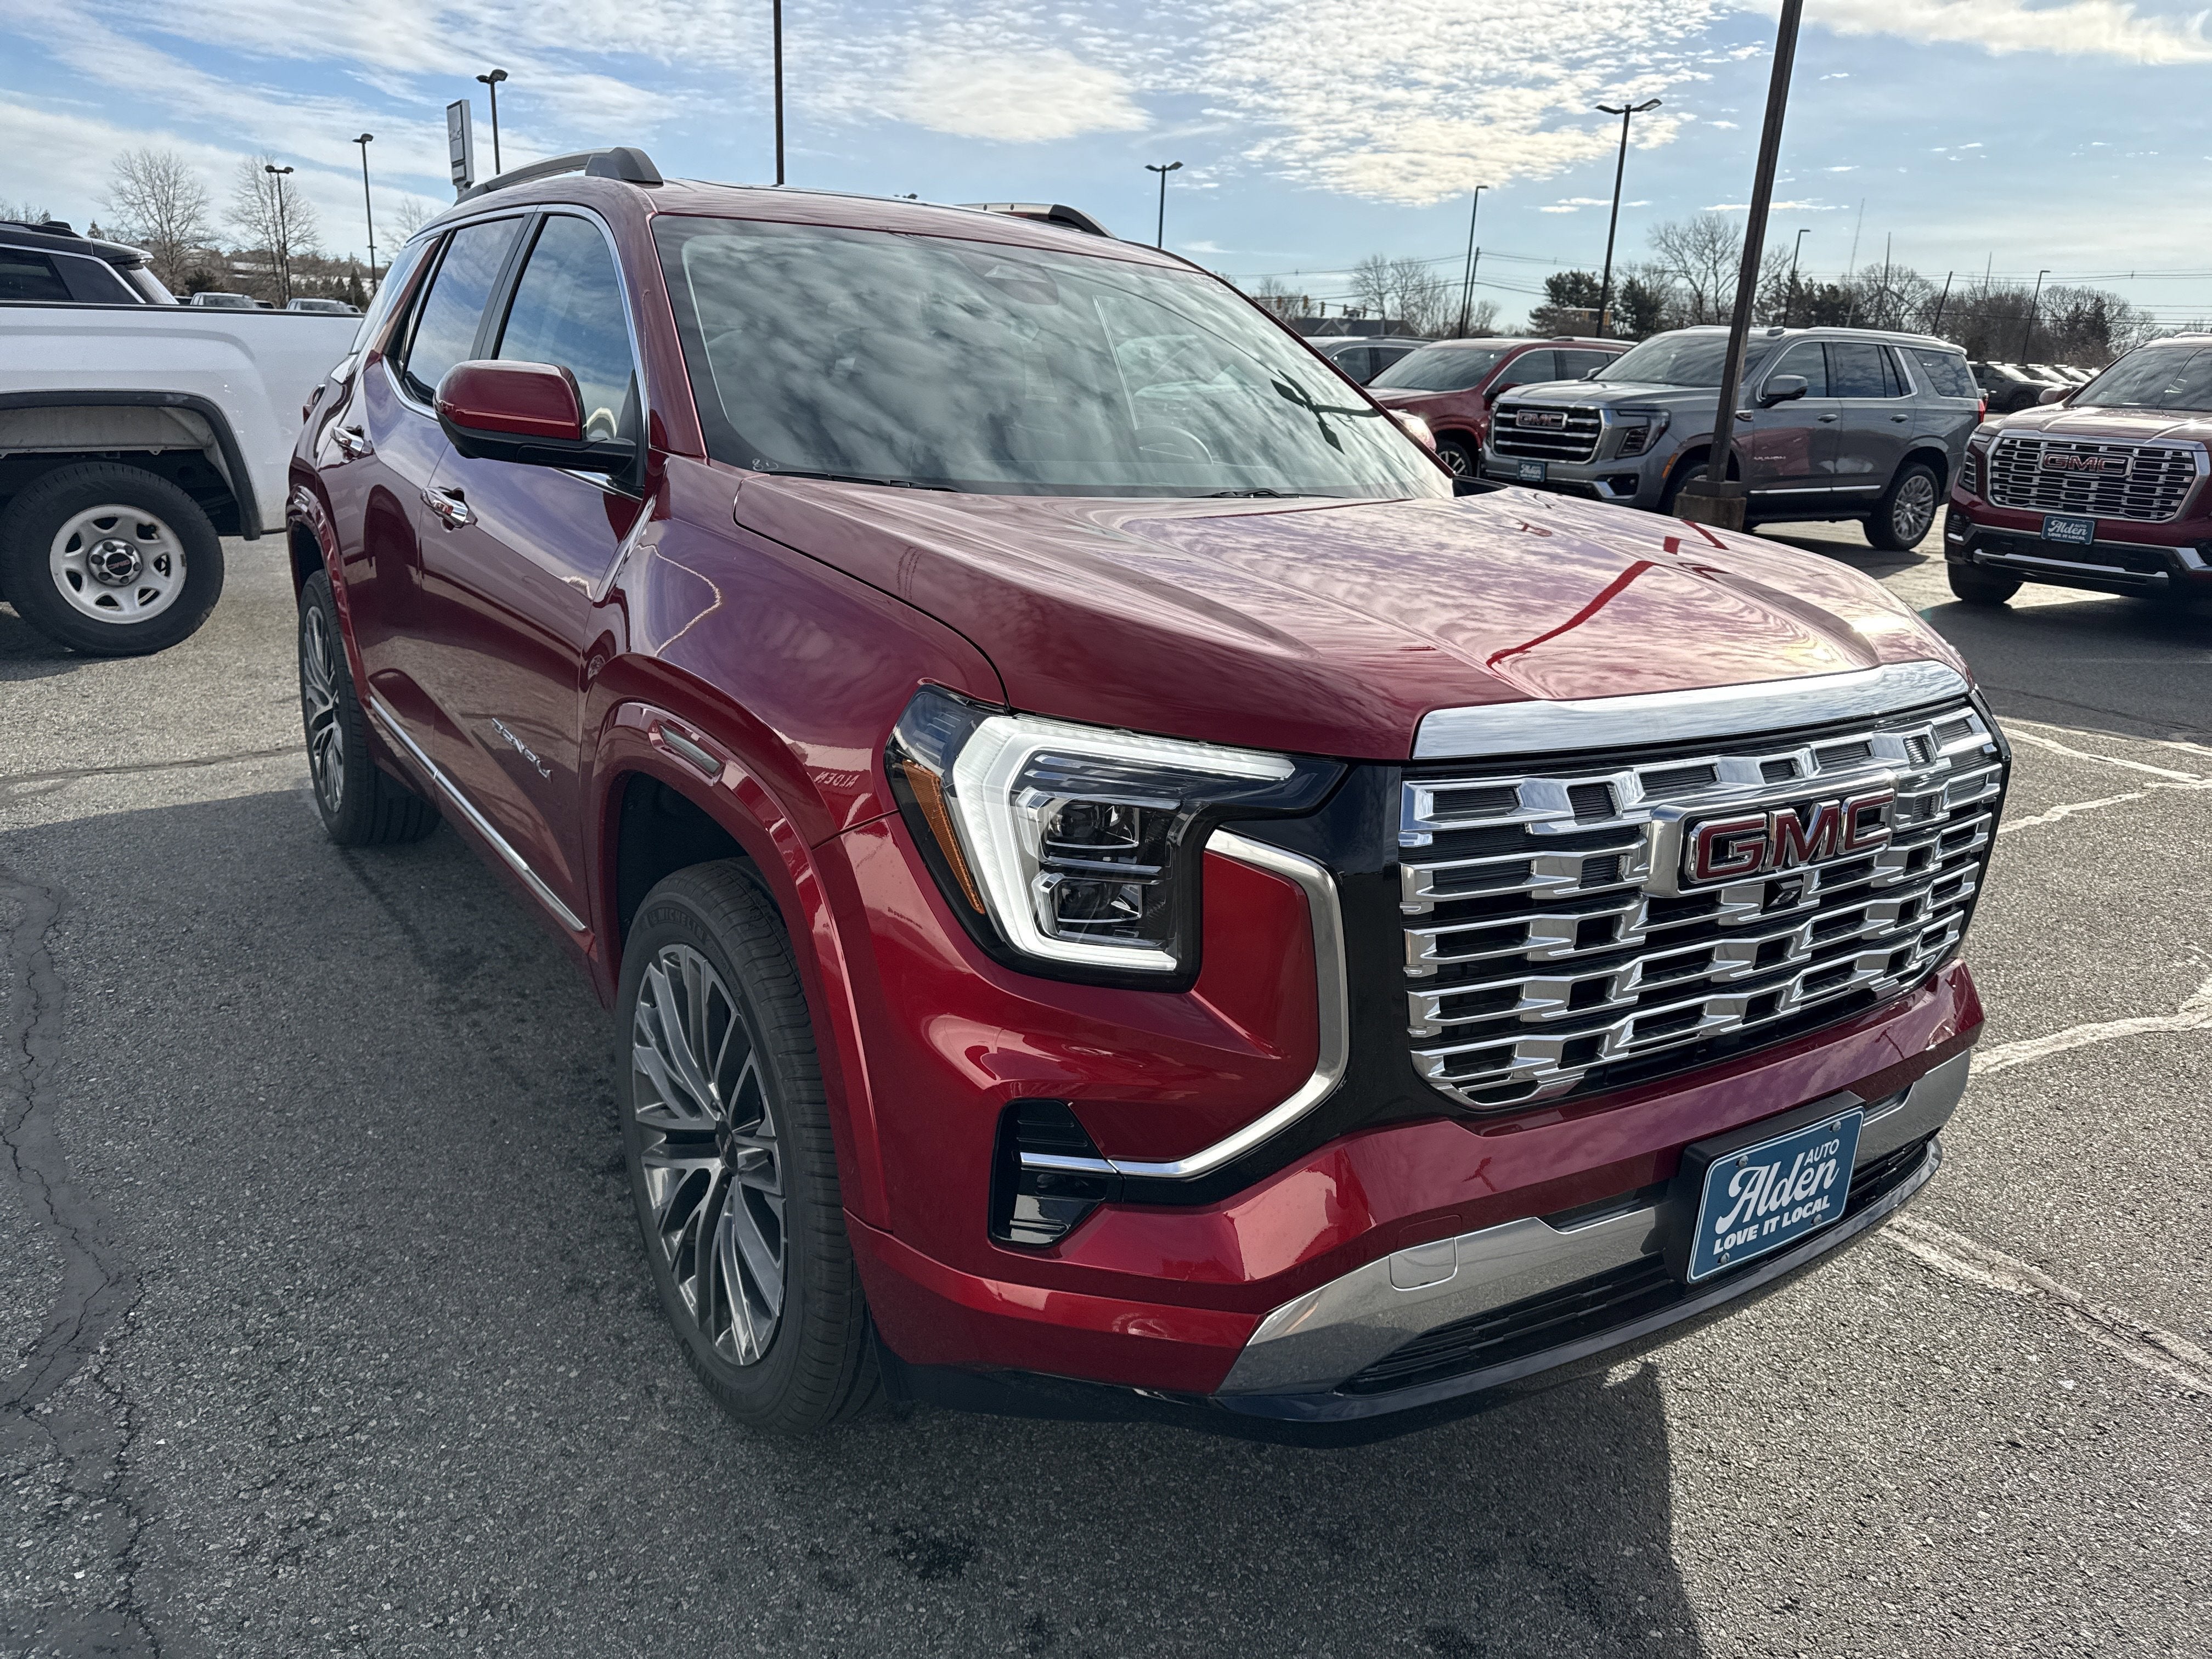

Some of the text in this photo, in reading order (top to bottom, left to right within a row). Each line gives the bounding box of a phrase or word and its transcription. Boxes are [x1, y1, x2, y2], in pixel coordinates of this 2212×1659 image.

[1519, 413, 1562, 427] GMC
[2044, 454, 2126, 473] GMC
[2047, 520, 2087, 535] Alden
[1686, 788, 1895, 883] GMC
[658, 907, 706, 943] MICHELIN
[1804, 1138, 1839, 1166] AUTO
[1715, 1152, 1839, 1234] Alden
[1713, 1195, 1830, 1255] LOVE IT LOCAL
